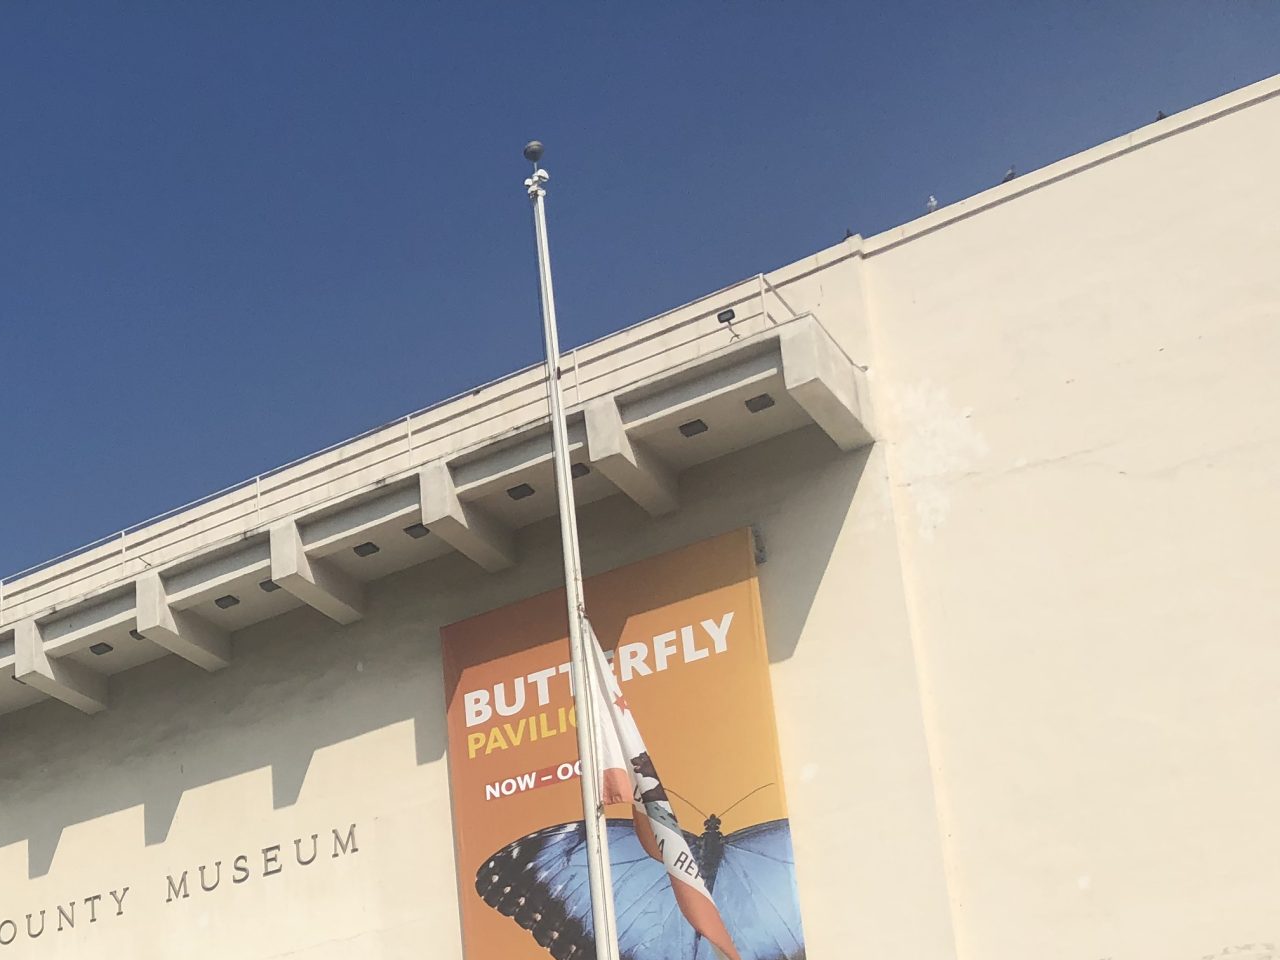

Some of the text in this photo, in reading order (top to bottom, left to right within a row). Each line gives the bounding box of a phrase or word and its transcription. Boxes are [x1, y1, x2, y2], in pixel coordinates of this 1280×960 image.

[463, 611, 735, 728] BUTTRFLY
[467, 704, 579, 760] PAVILI
[485, 771, 537, 801] NOW
[165, 823, 360, 903] MUSEUM
